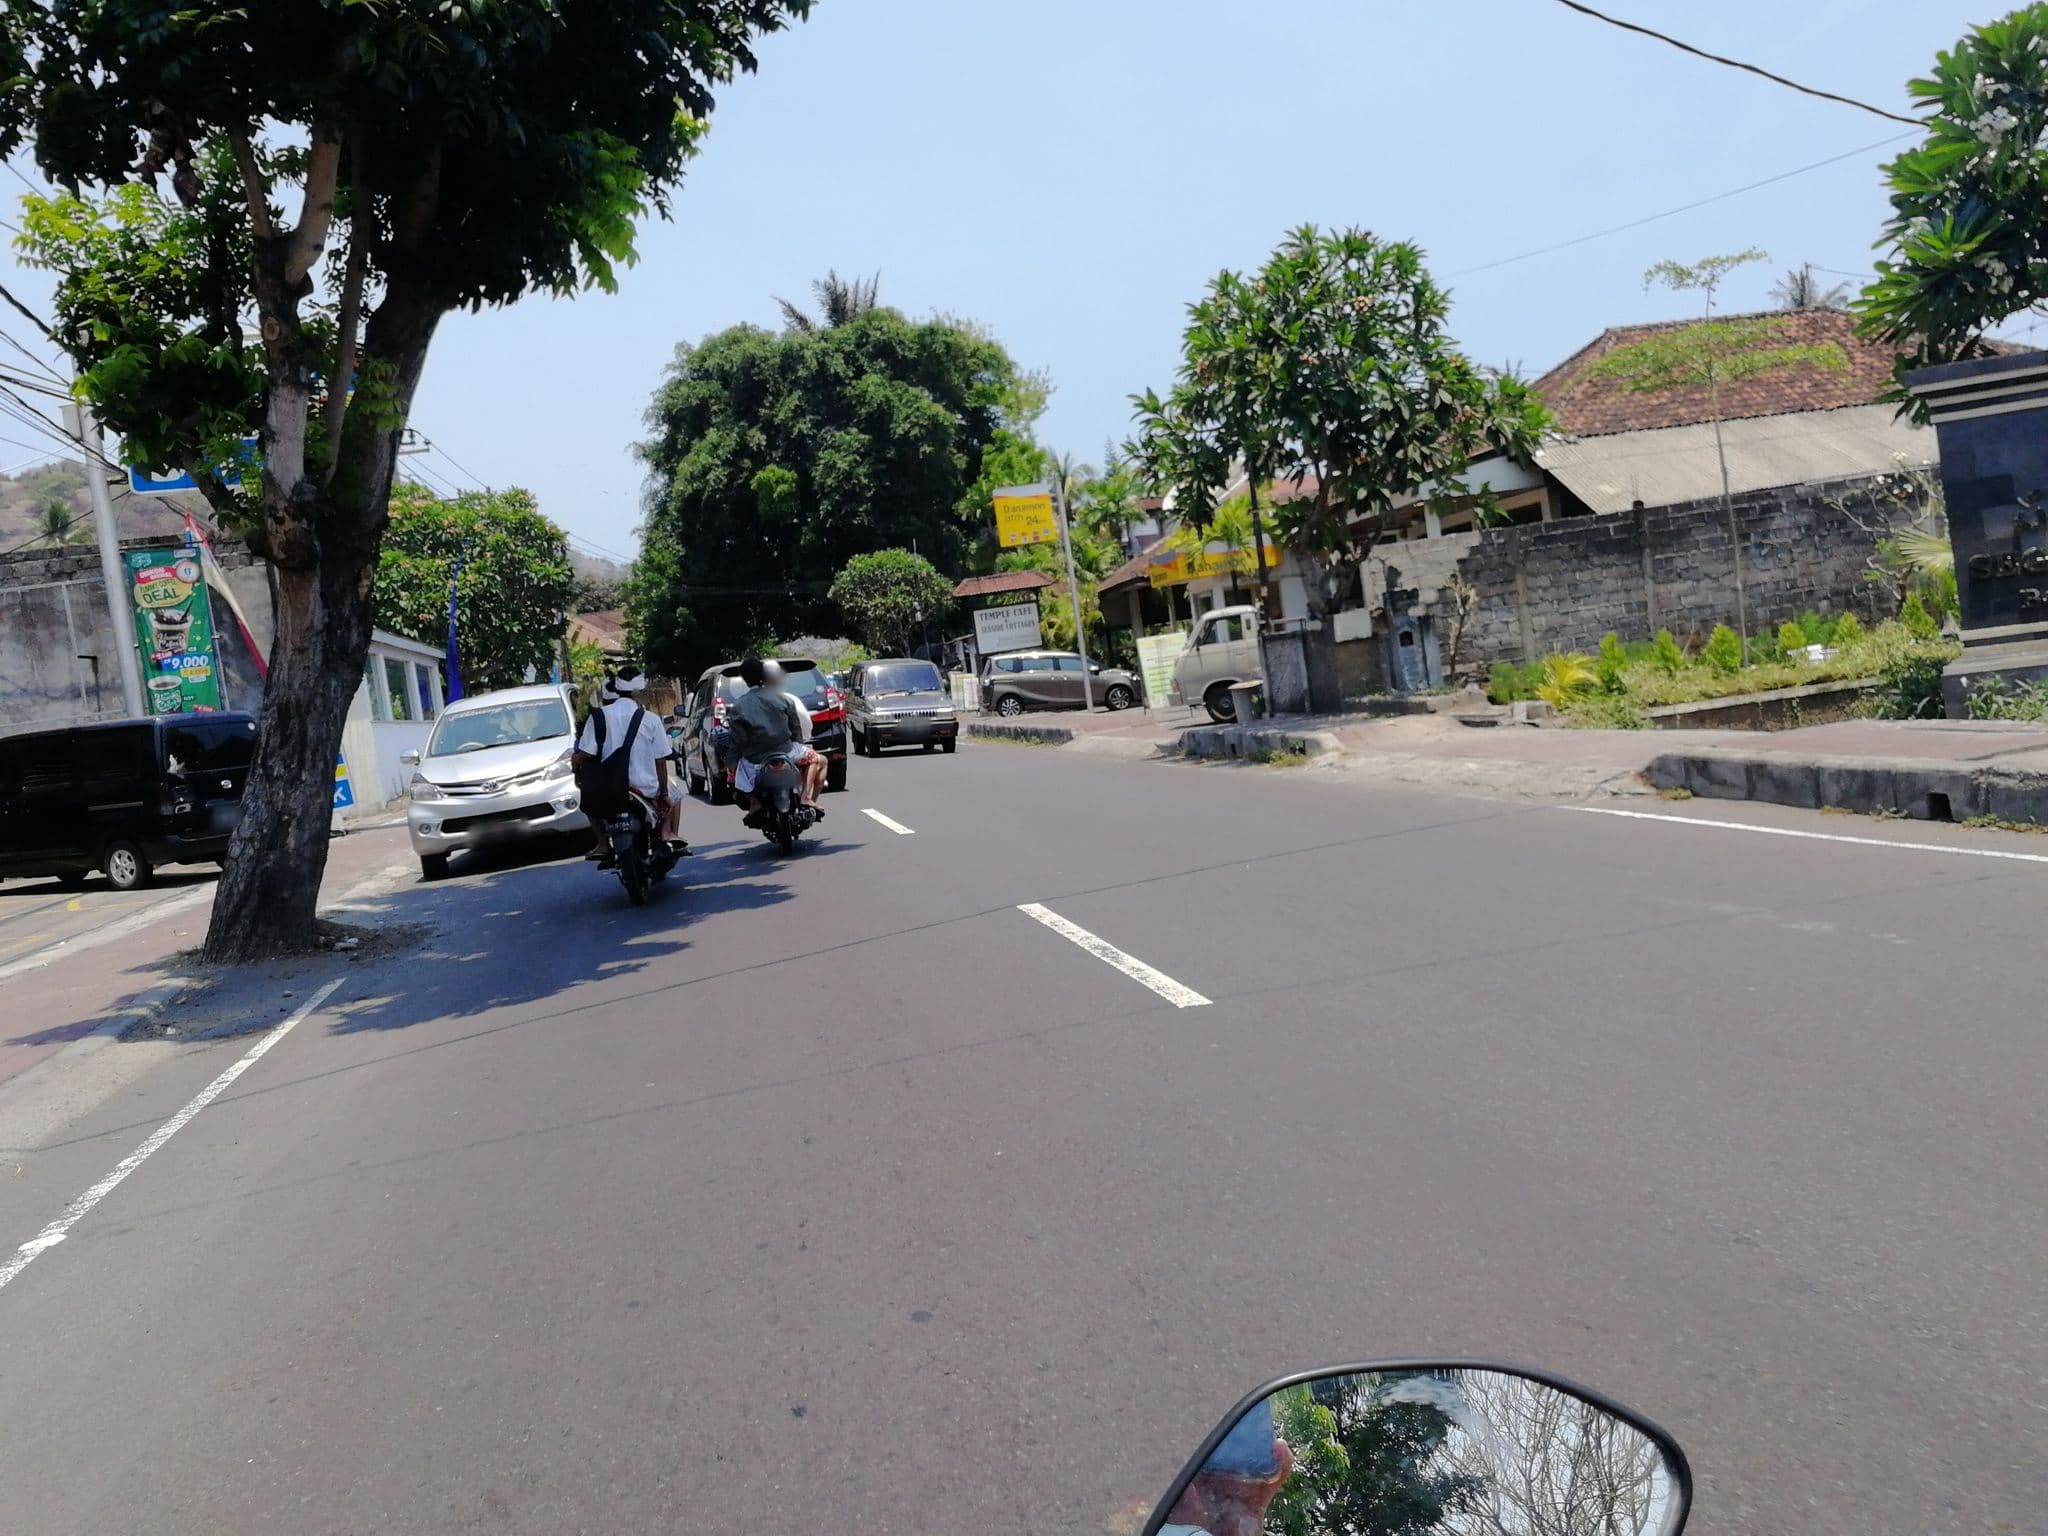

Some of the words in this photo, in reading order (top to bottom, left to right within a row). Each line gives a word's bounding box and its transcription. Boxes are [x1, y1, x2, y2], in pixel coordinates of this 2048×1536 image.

[142, 588, 180, 604] DEAL
[979, 610, 1010, 622] TEMPLE
[1013, 606, 1032, 617] CAFE
[172, 655, 209, 669] 9.000
